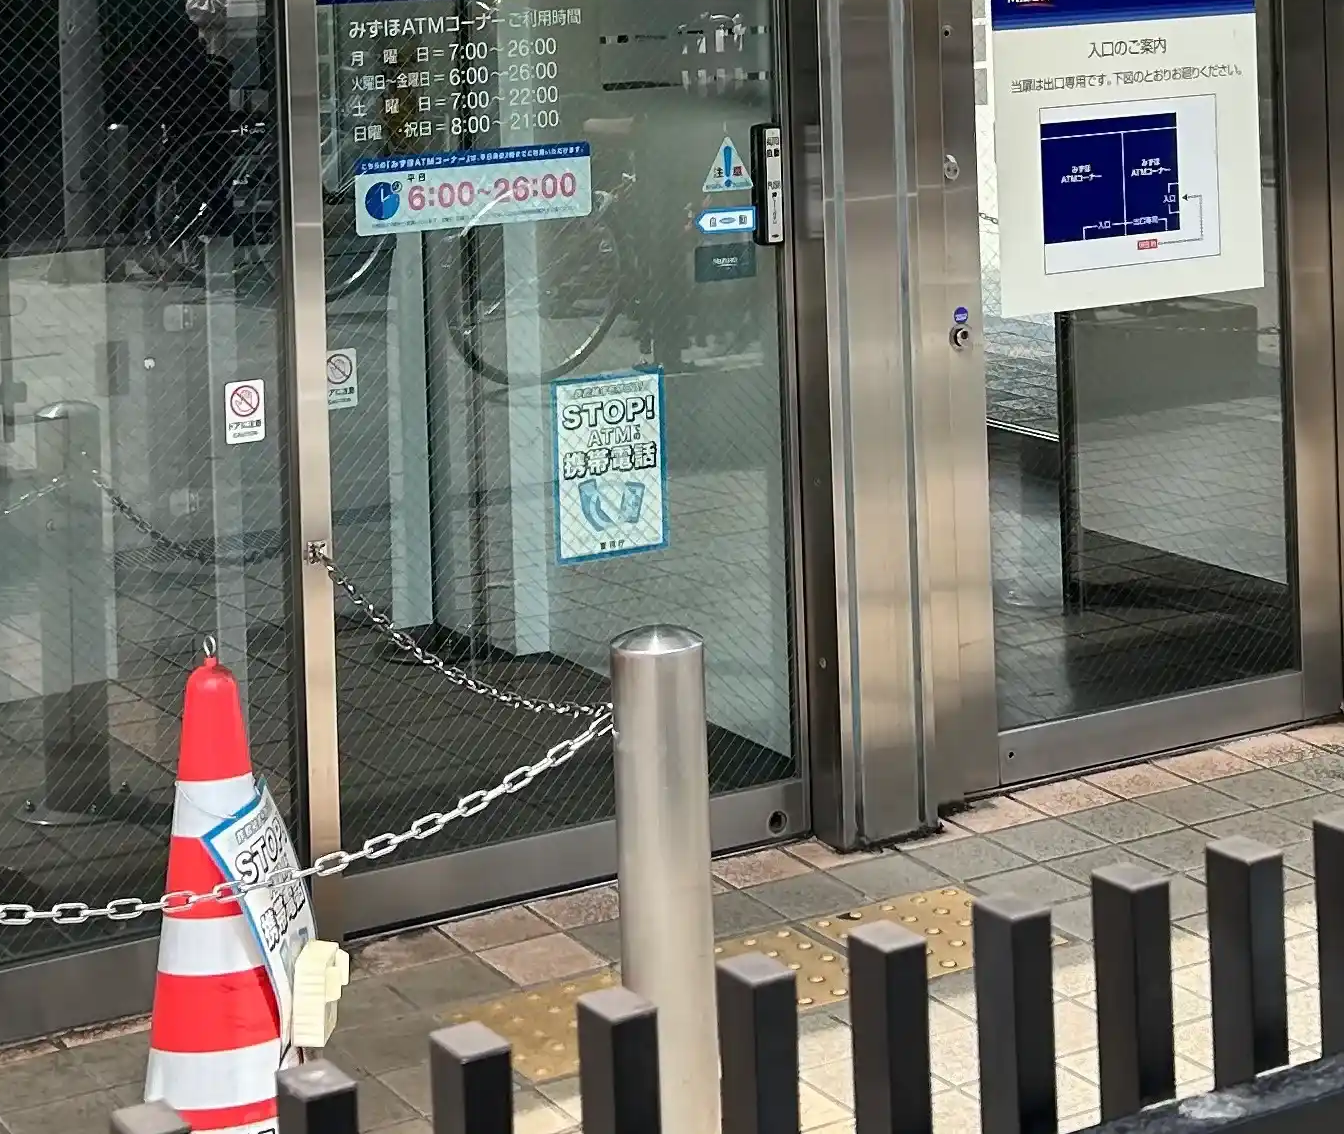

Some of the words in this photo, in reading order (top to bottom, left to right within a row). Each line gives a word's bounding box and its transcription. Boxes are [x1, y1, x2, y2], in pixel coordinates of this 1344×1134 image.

[1088, 37, 1168, 59] 入口のご案内
[1162, 193, 1177, 204] 入口
[1097, 220, 1112, 230] 入口
[562, 395, 655, 431] STOP!
[563, 440, 657, 481] 携帯電話
